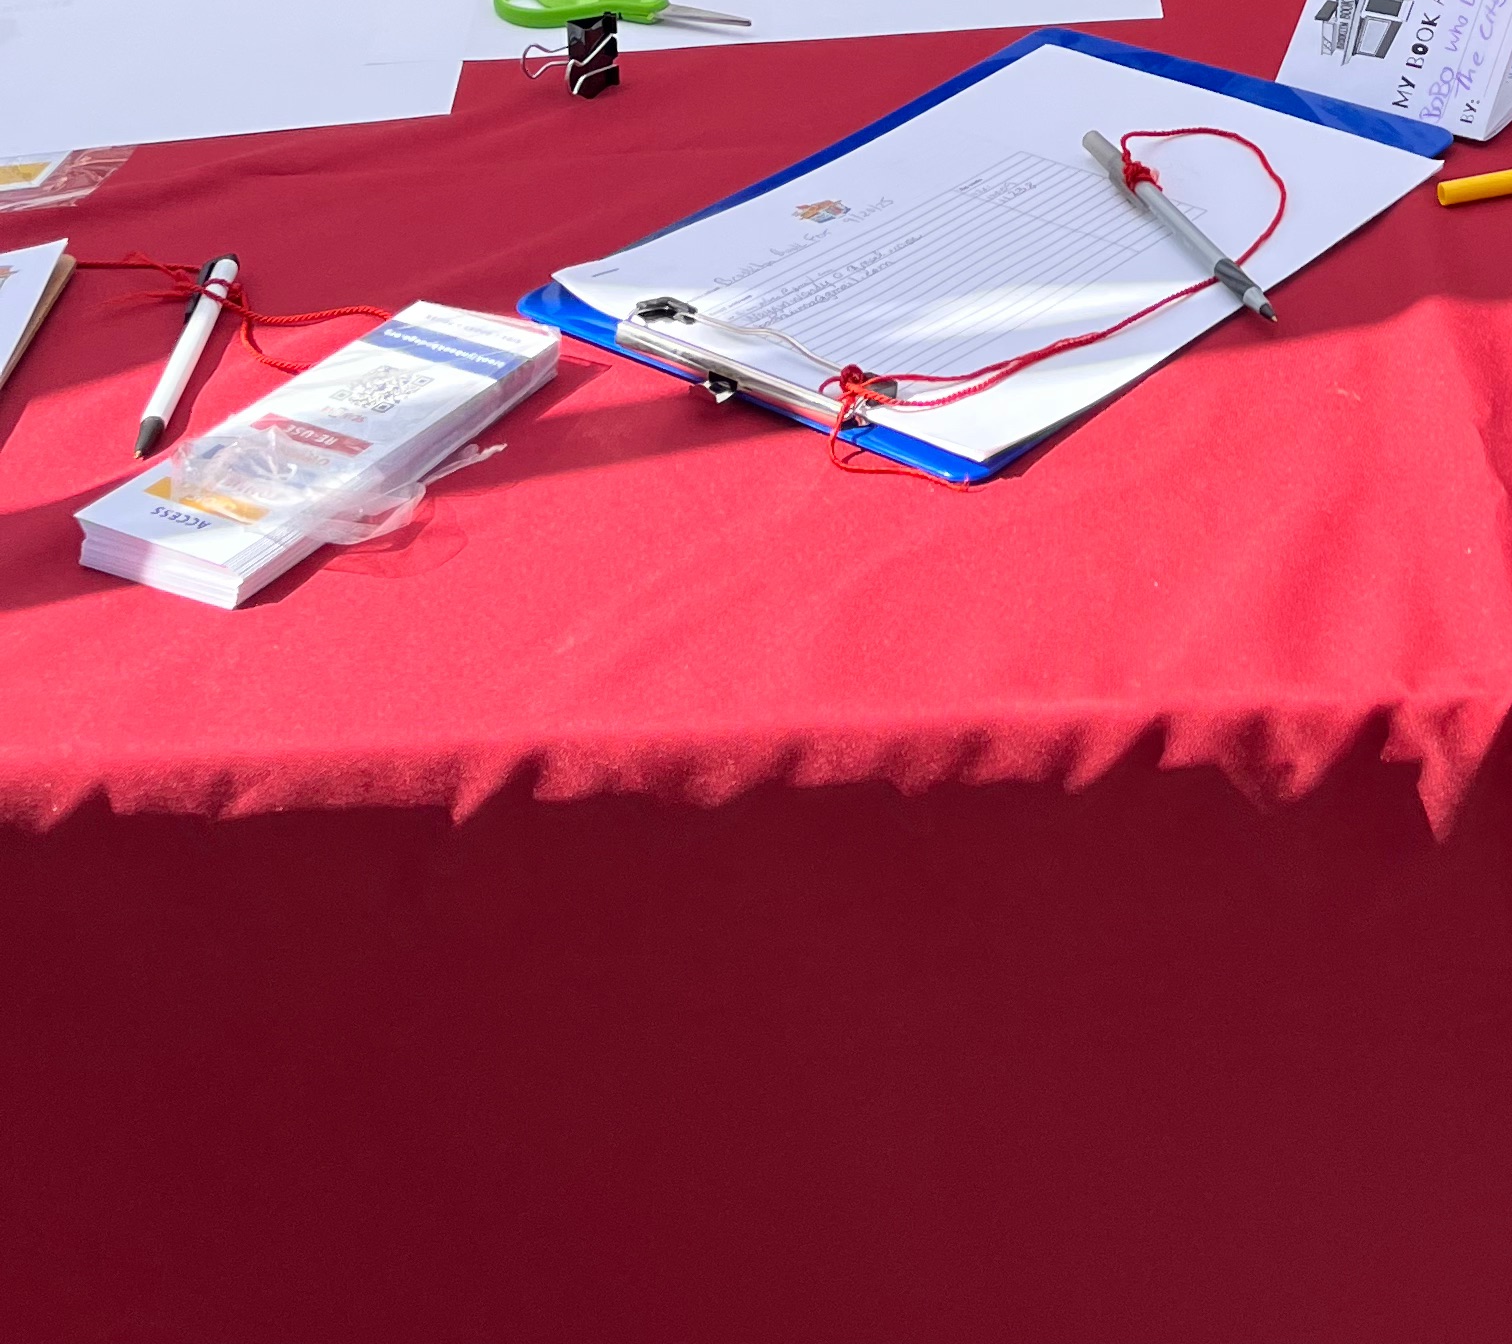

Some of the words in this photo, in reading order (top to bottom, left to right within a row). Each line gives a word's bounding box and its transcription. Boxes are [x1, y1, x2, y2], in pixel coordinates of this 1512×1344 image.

[1392, 75, 1416, 109] MY
[1405, 12, 1441, 69] BOOK
[1460, 98, 1480, 124] BY:
[149, 504, 212, 531] ACCESS
